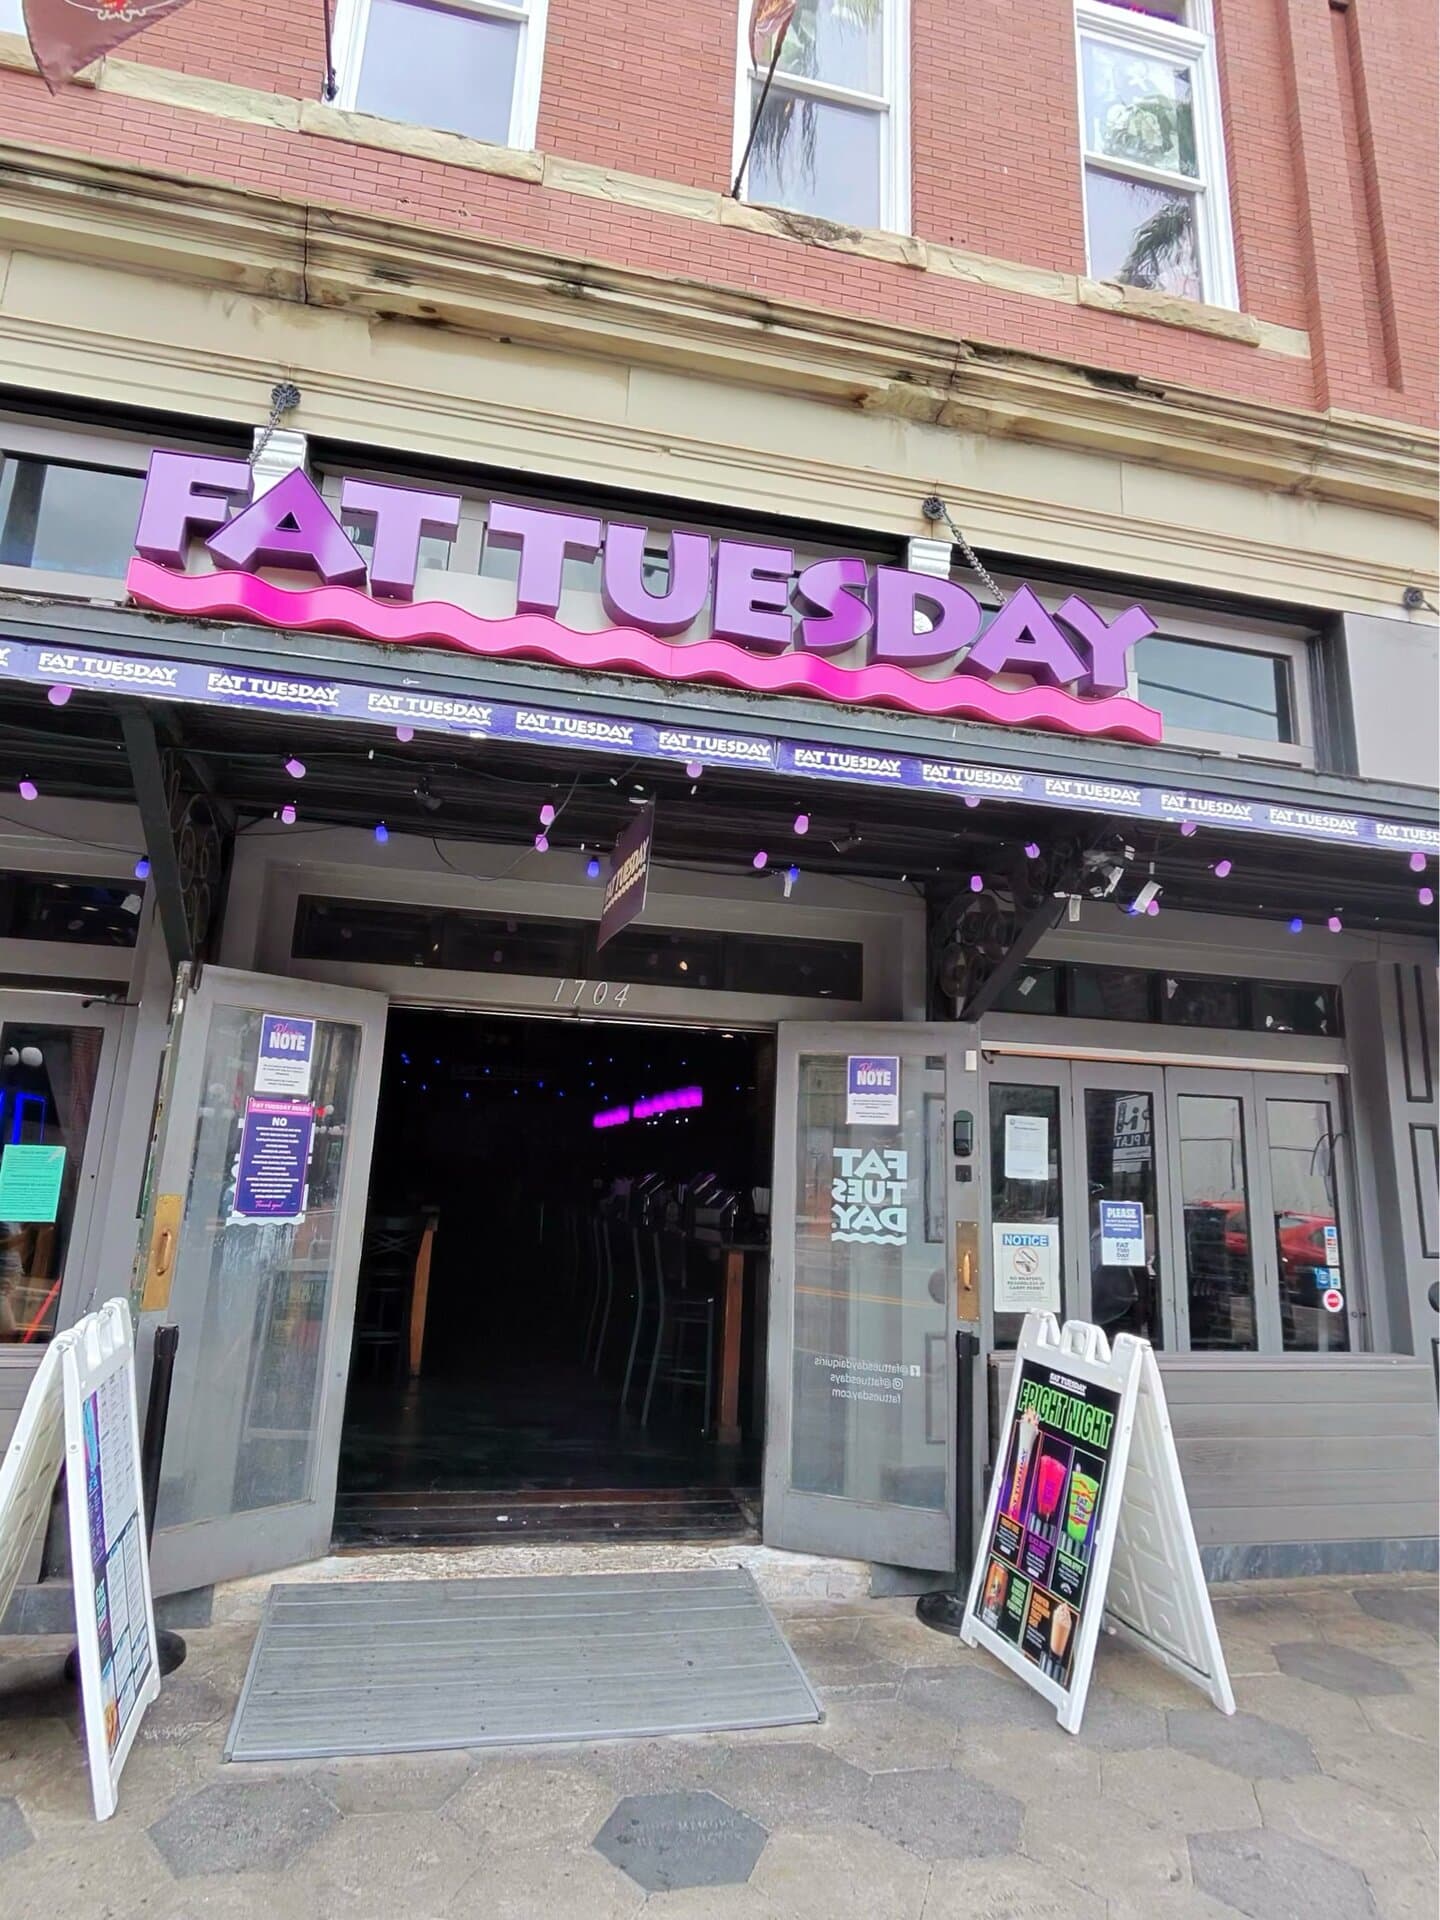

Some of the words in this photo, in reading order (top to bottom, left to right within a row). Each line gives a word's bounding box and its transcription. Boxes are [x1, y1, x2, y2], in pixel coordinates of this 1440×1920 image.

[135, 449, 461, 600] FAT
[488, 500, 1158, 698] TUESDAY
[38, 652, 79, 671] FAT
[82, 657, 178, 682] TUESDAY
[208, 673, 249, 689] FAT
[249, 678, 340, 701] TUESDAY
[368, 693, 404, 708] FAT
[405, 697, 493, 720] TUESDAY
[516, 711, 552, 728] FAT
[553, 716, 634, 739] TUESDAY
[659, 731, 692, 748] FAT
[693, 736, 771, 757] TUESDAY
[794, 749, 826, 764] FAT
[827, 752, 901, 772] TUESDAY
[922, 763, 952, 778] FAT
[953, 768, 1023, 786] TUESDAY
[1045, 779, 1074, 793] FAT
[1075, 783, 1141, 801] TUESDAY
[1161, 794, 1188, 808] FAT
[1188, 797, 1251, 816] TUESDAY
[1270, 808, 1296, 822] FAT
[1296, 810, 1358, 830] TUESDAY
[1376, 823, 1400, 837] FAT
[553, 978, 630, 1008] 1704
[269, 1031, 306, 1051] NOTE
[857, 1070, 891, 1086] NOTE
[271, 1117, 287, 1126] NO
[1004, 1235, 1048, 1246] NOTICE
[1017, 1378, 1069, 1429] FRIGHT
[1064, 1396, 1114, 1449] NIGHT
